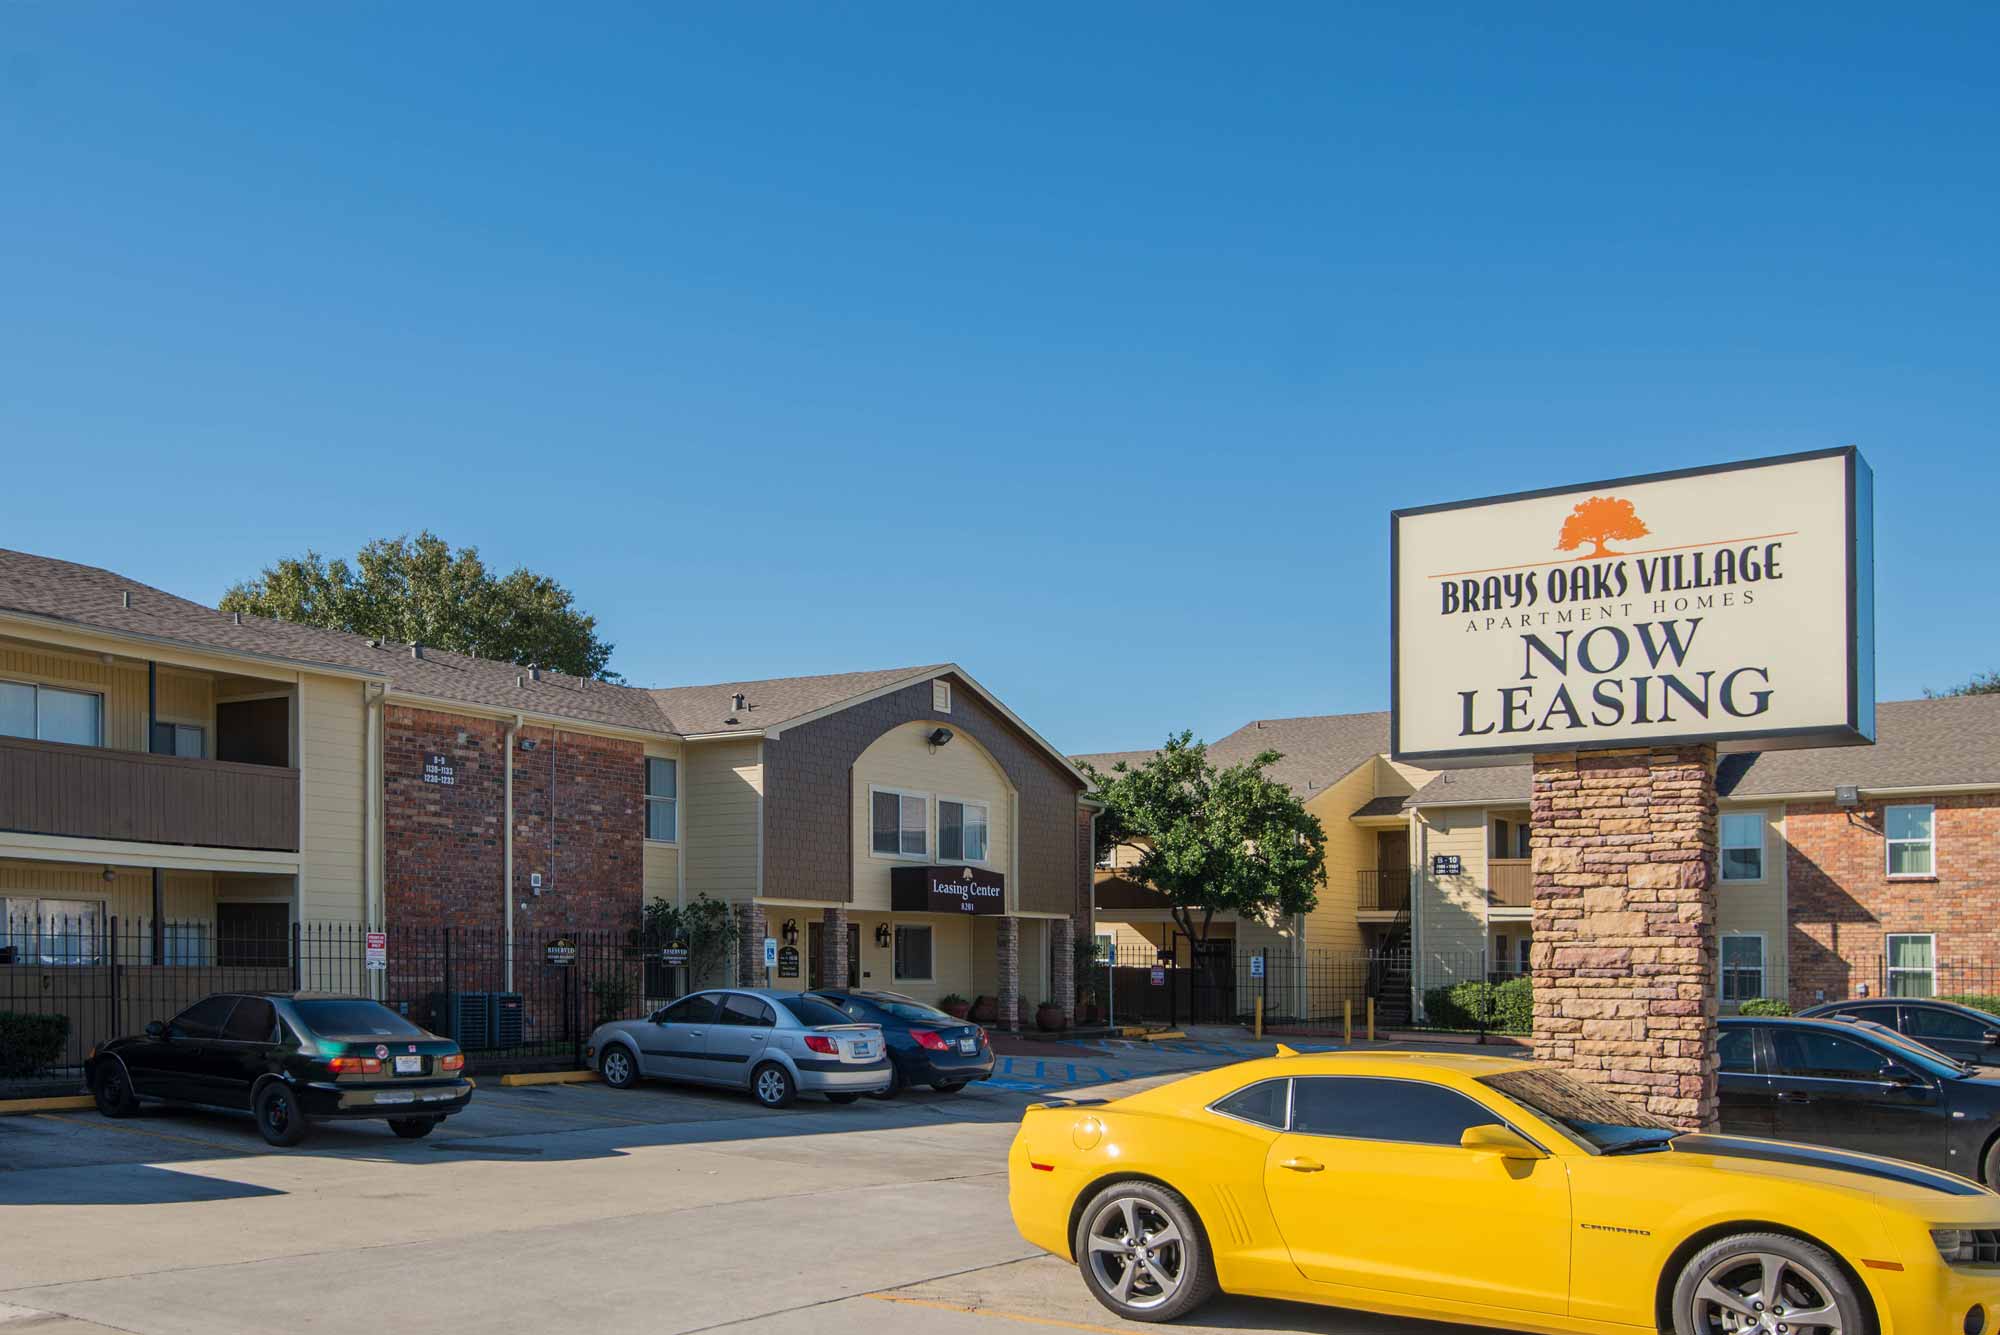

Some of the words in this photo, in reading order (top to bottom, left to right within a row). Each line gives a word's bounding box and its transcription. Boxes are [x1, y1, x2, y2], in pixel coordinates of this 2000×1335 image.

[1441, 571, 1538, 615] BRAYS
[1547, 560, 1628, 604] OAKS
[1636, 542, 1783, 594] VILLAGE
[1466, 602, 1633, 632] APARTMENT
[1653, 590, 1756, 614] HOMES
[1520, 617, 1703, 680] NOW
[1457, 666, 1774, 736] LEASING
[933, 879, 969, 900] Leasing
[970, 882, 1000, 897] Center
[1580, 1223, 1651, 1236] CAMARO
